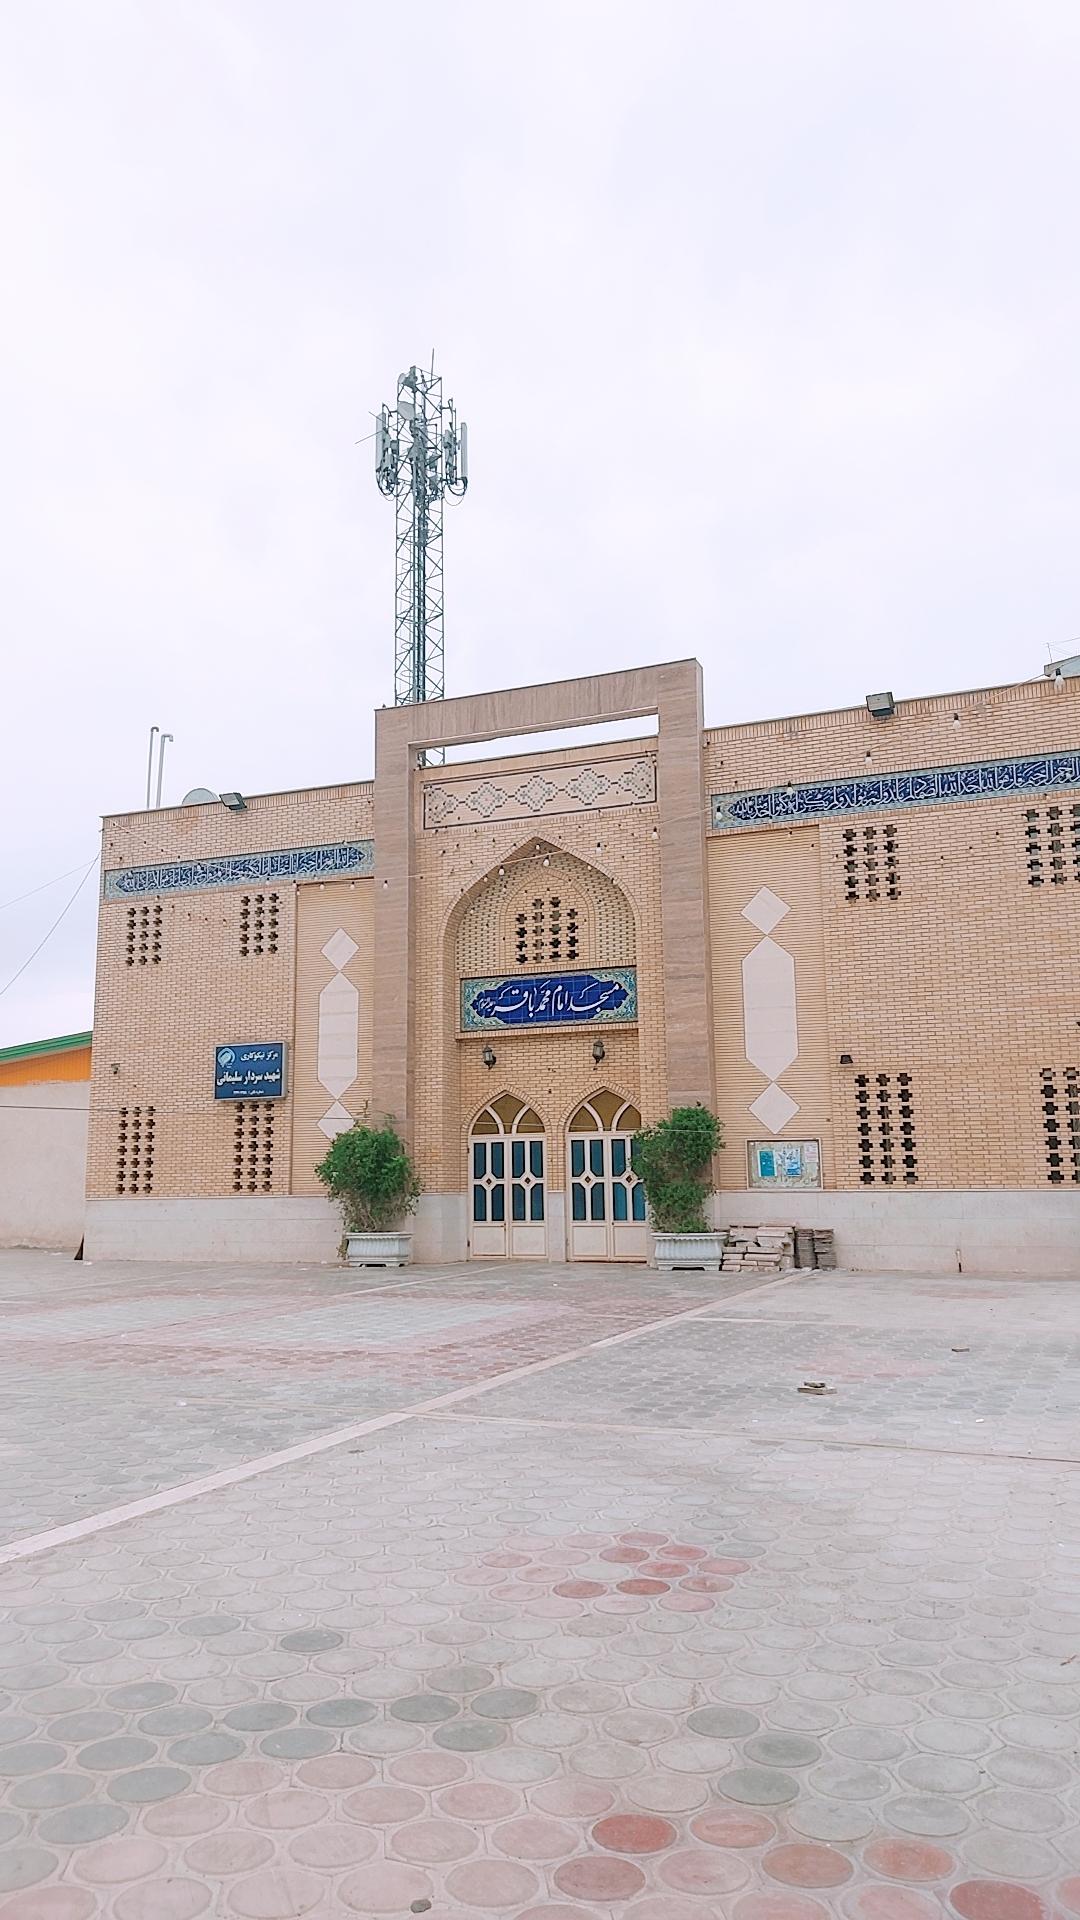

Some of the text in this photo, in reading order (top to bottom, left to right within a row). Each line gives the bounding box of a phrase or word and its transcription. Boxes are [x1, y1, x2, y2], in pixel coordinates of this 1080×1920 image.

[491, 985, 535, 1018] باقر
[535, 981, 551, 1013] محمد
[551, 984, 569, 1016] امام
[567, 982, 620, 1013] مسجد
[240, 1050, 279, 1062] مرکز نیکوکاری
[216, 1068, 281, 1086] شهید سردار سلیمانی
